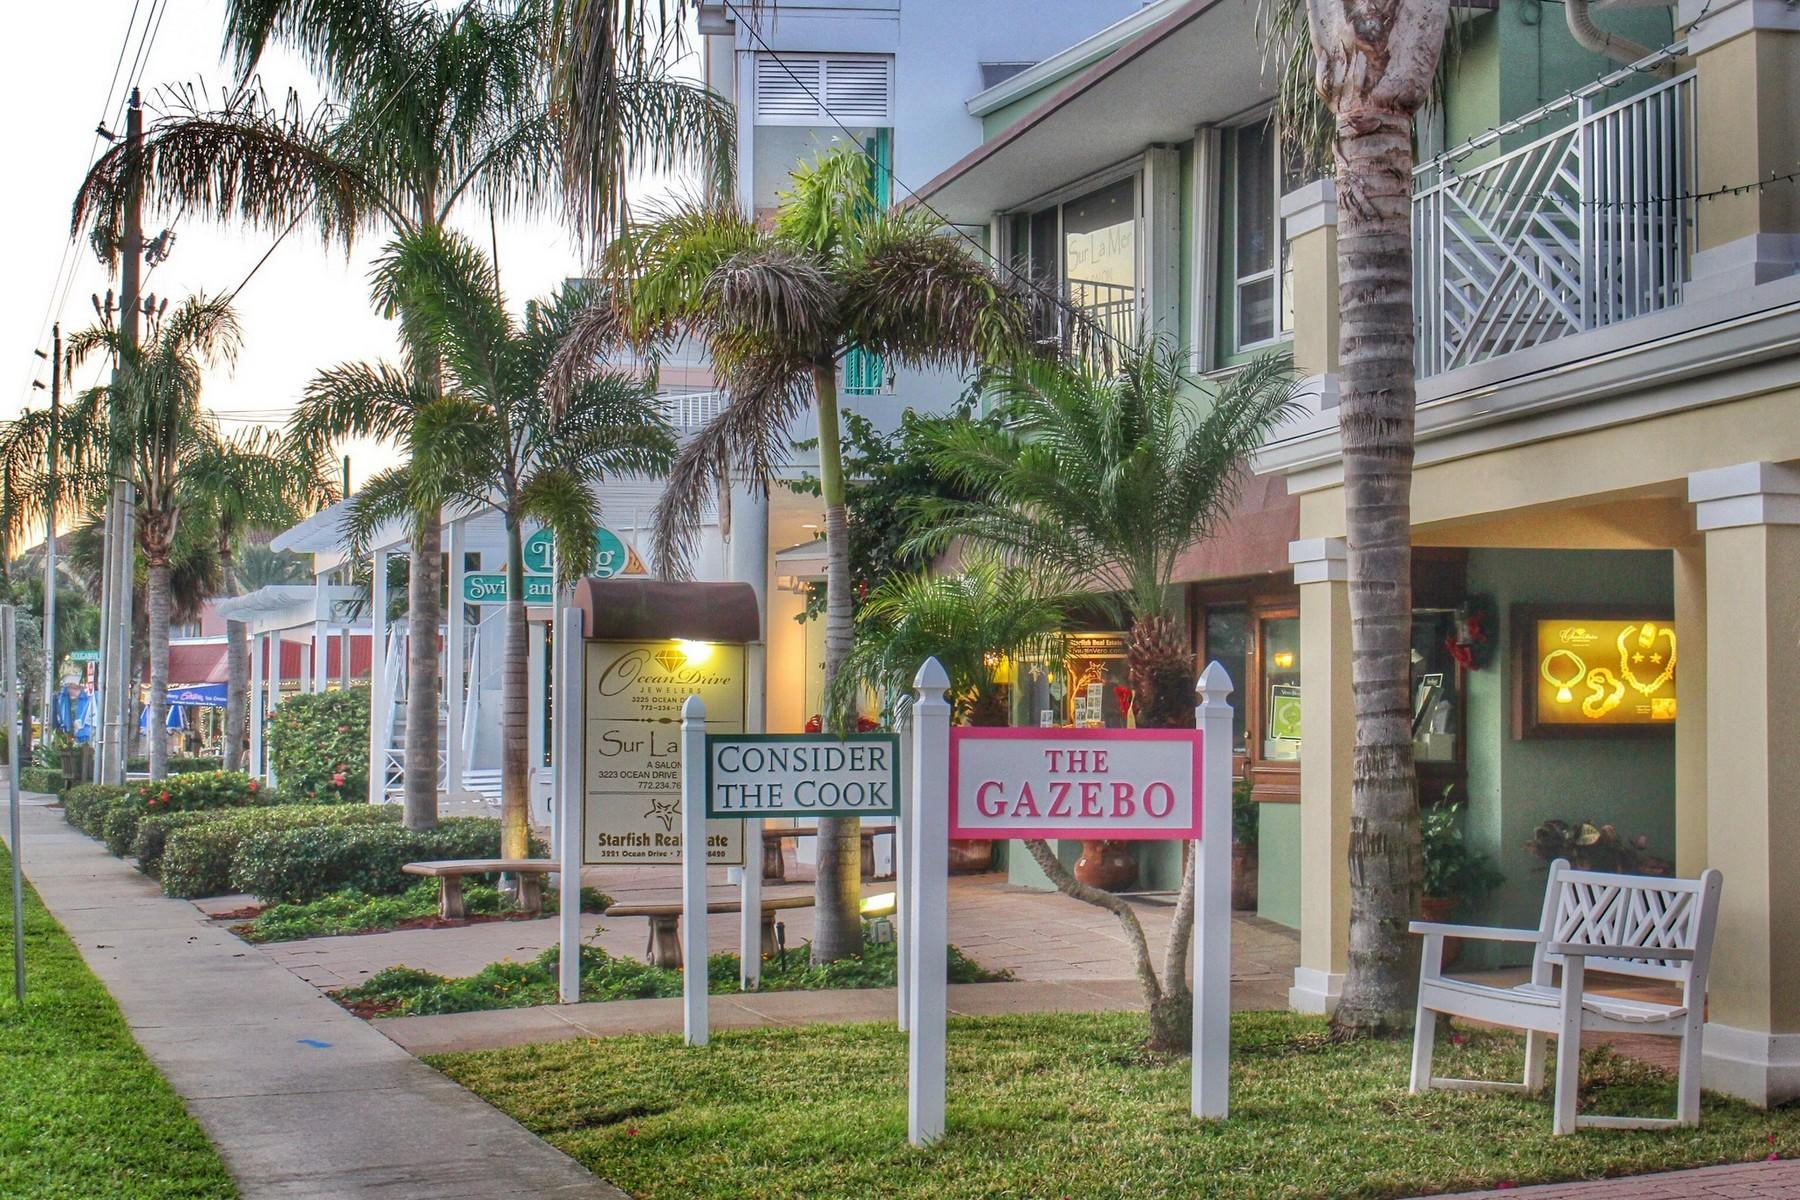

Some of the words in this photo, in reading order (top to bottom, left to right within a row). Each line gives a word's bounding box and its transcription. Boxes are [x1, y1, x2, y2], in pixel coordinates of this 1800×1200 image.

[1091, 233, 1106, 264] La
[598, 648, 674, 697] Ocean
[676, 668, 731, 685] Drive
[598, 730, 645, 756] Sur
[650, 730, 678, 757] La
[646, 761, 653, 769] A
[717, 745, 888, 773] CONSIDER
[1044, 750, 1109, 773] THE
[598, 771, 618, 779] 3223
[620, 771, 650, 779] OCEAN
[652, 771, 678, 779] DRIVE
[717, 783, 783, 808] THE
[794, 780, 888, 808] COOK
[975, 781, 1175, 818] GAZEBO
[598, 832, 651, 847] Starfish
